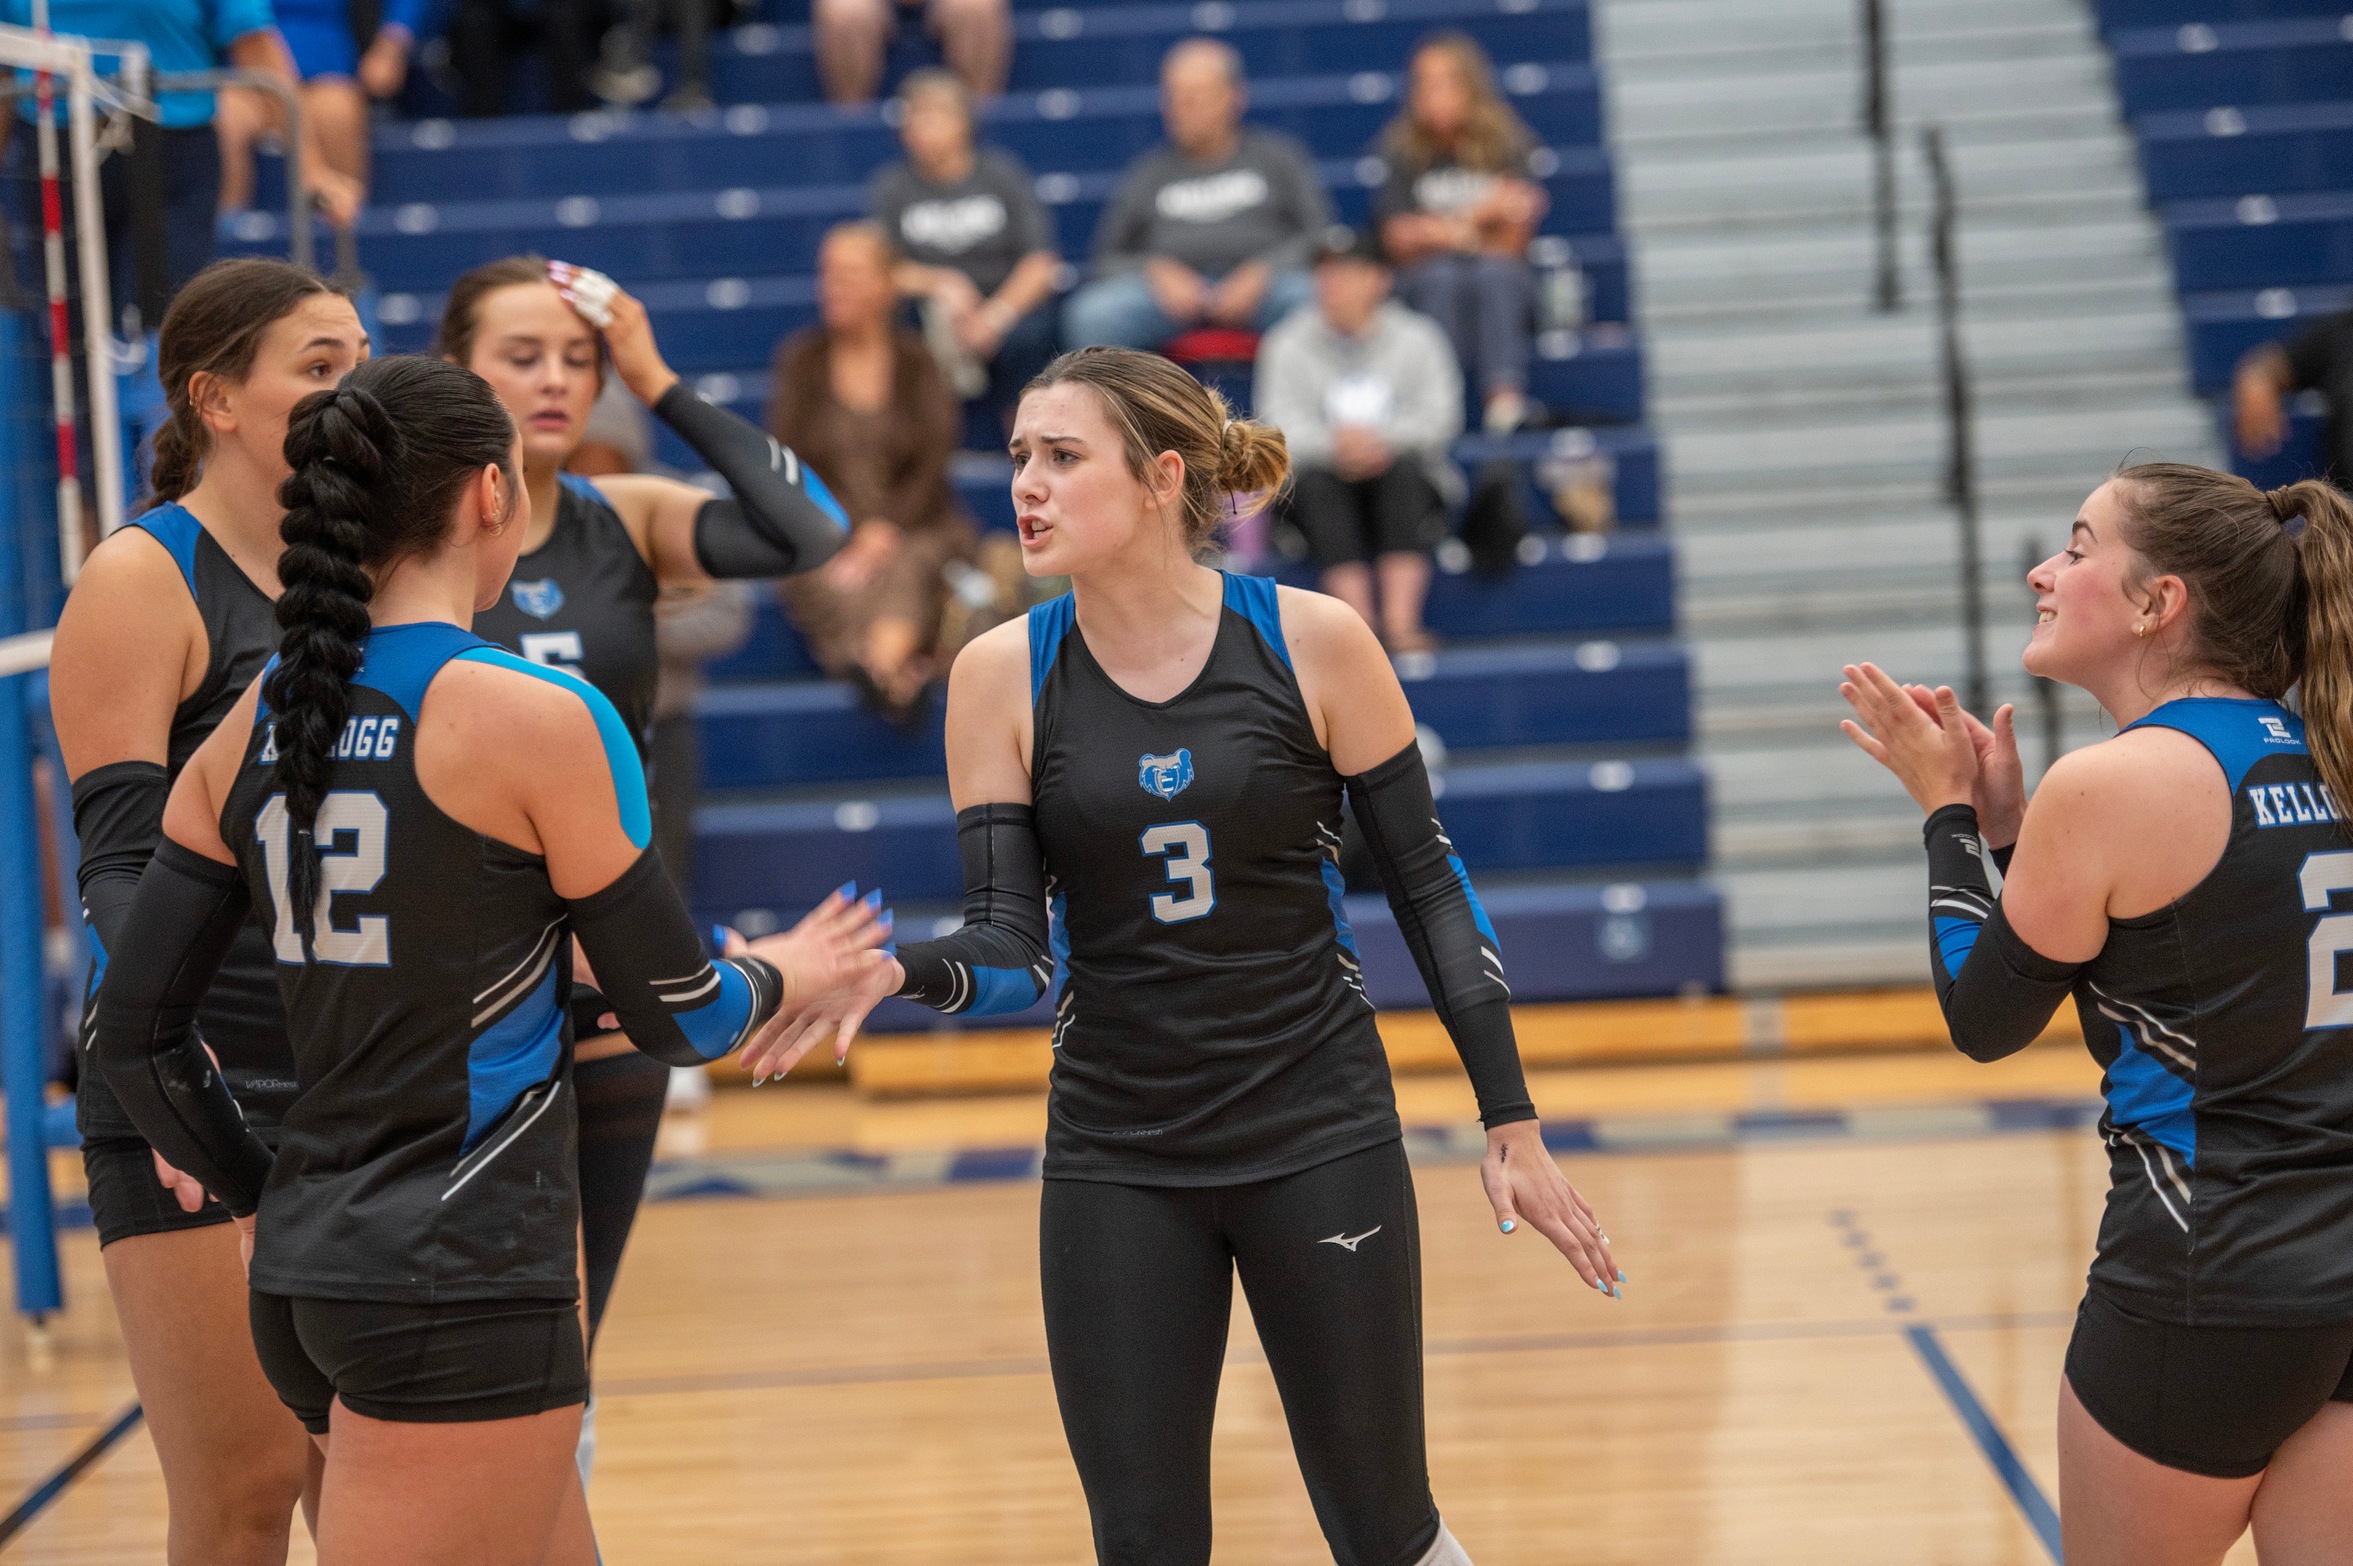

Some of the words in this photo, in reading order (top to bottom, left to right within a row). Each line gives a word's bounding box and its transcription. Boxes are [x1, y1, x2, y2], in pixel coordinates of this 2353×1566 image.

[258, 714, 402, 766] KOGG
[2245, 781, 2343, 829] KELLO
[253, 789, 393, 968] 12
[1138, 819, 1217, 925] 3
[2296, 851, 2353, 1031] 2
